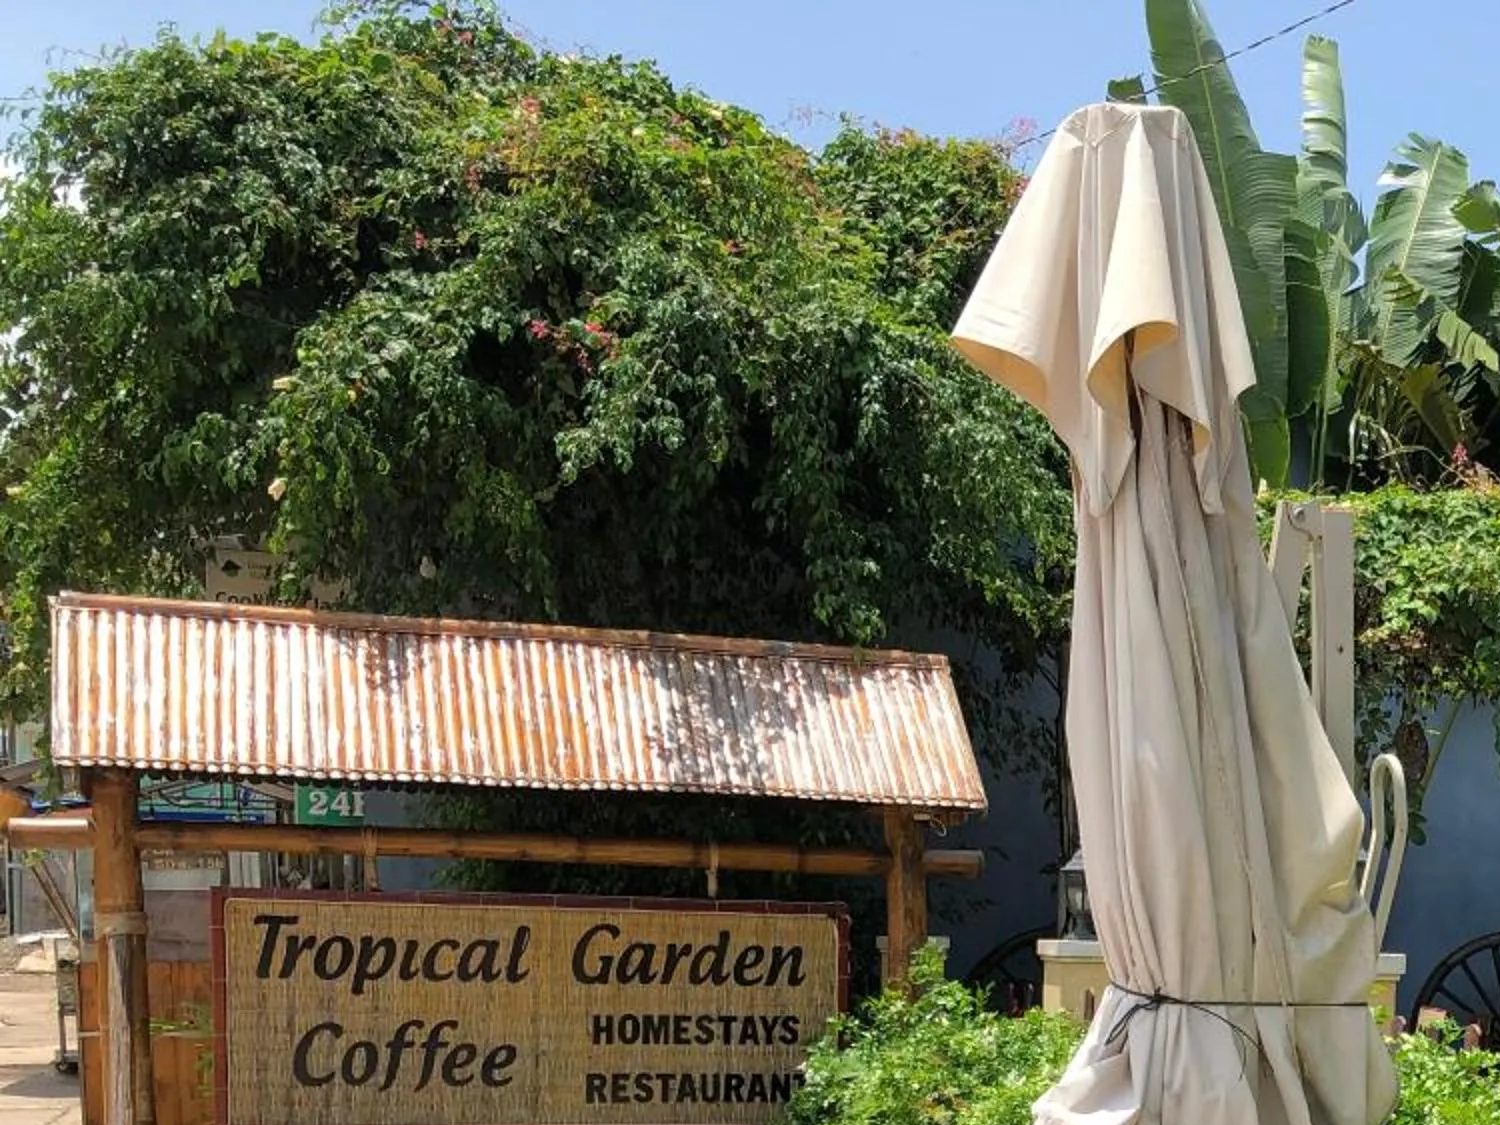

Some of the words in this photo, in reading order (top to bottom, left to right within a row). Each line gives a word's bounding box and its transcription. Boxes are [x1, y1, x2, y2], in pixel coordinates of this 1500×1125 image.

[254, 914, 531, 995] Tropical
[572, 923, 807, 988] Garden
[292, 1019, 517, 1093] Coffee
[593, 1014, 800, 1047] HOMESTAYS
